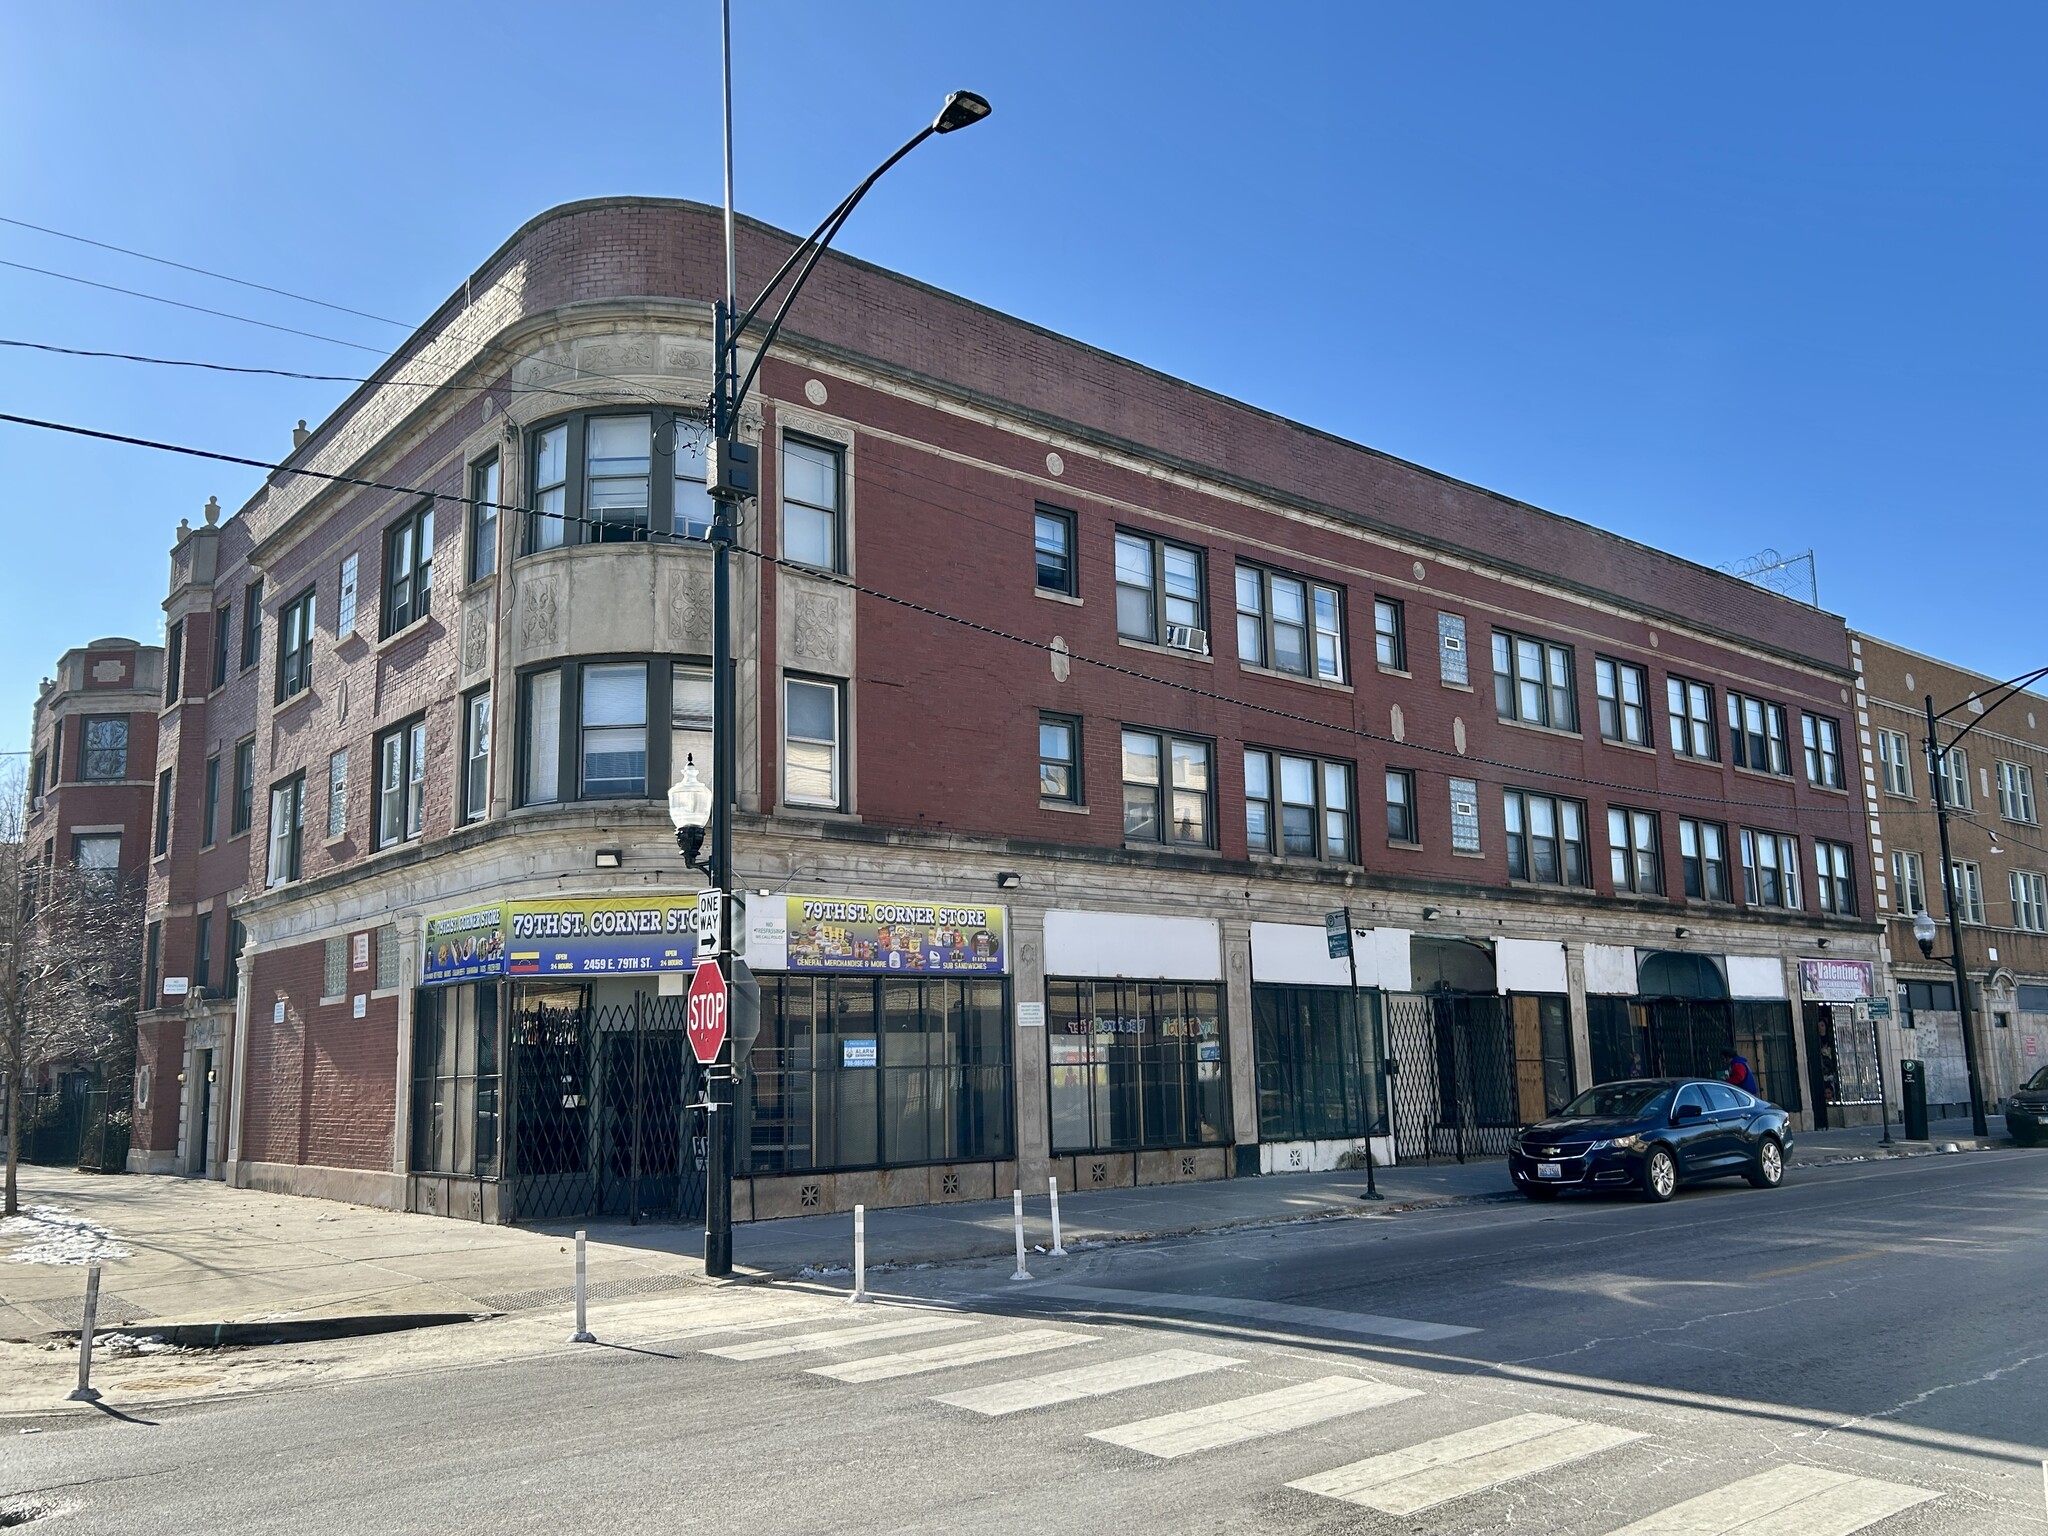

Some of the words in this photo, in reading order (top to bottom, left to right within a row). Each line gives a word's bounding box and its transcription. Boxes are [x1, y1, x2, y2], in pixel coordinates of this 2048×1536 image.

[700, 896, 718, 912] ONE
[481, 908, 500, 928] STORE
[803, 901, 845, 920] 79TH
[847, 903, 873, 922] ST.
[874, 905, 935, 925] CORNER
[939, 908, 986, 927] STORE
[513, 913, 560, 938] 79TH
[560, 911, 588, 937] ST.
[589, 909, 661, 935] CORNER
[665, 907, 698, 932] STO
[700, 914, 719, 931] WAY
[555, 953, 568, 961] OPEN
[584, 959, 606, 970] 2459
[607, 959, 615, 970] E.
[617, 958, 639, 969] 79TH
[640, 957, 653, 969] ST.
[668, 959, 684, 967] HOURS
[797, 959, 822, 967] GENERAL
[824, 959, 864, 967] MERCHANDISE
[870, 960, 886, 968] MORE
[558, 962, 574, 970] HOURS
[954, 962, 987, 970] SANDWICHES
[1817, 962, 1859, 980] Valentine
[690, 992, 724, 1030] STOP
